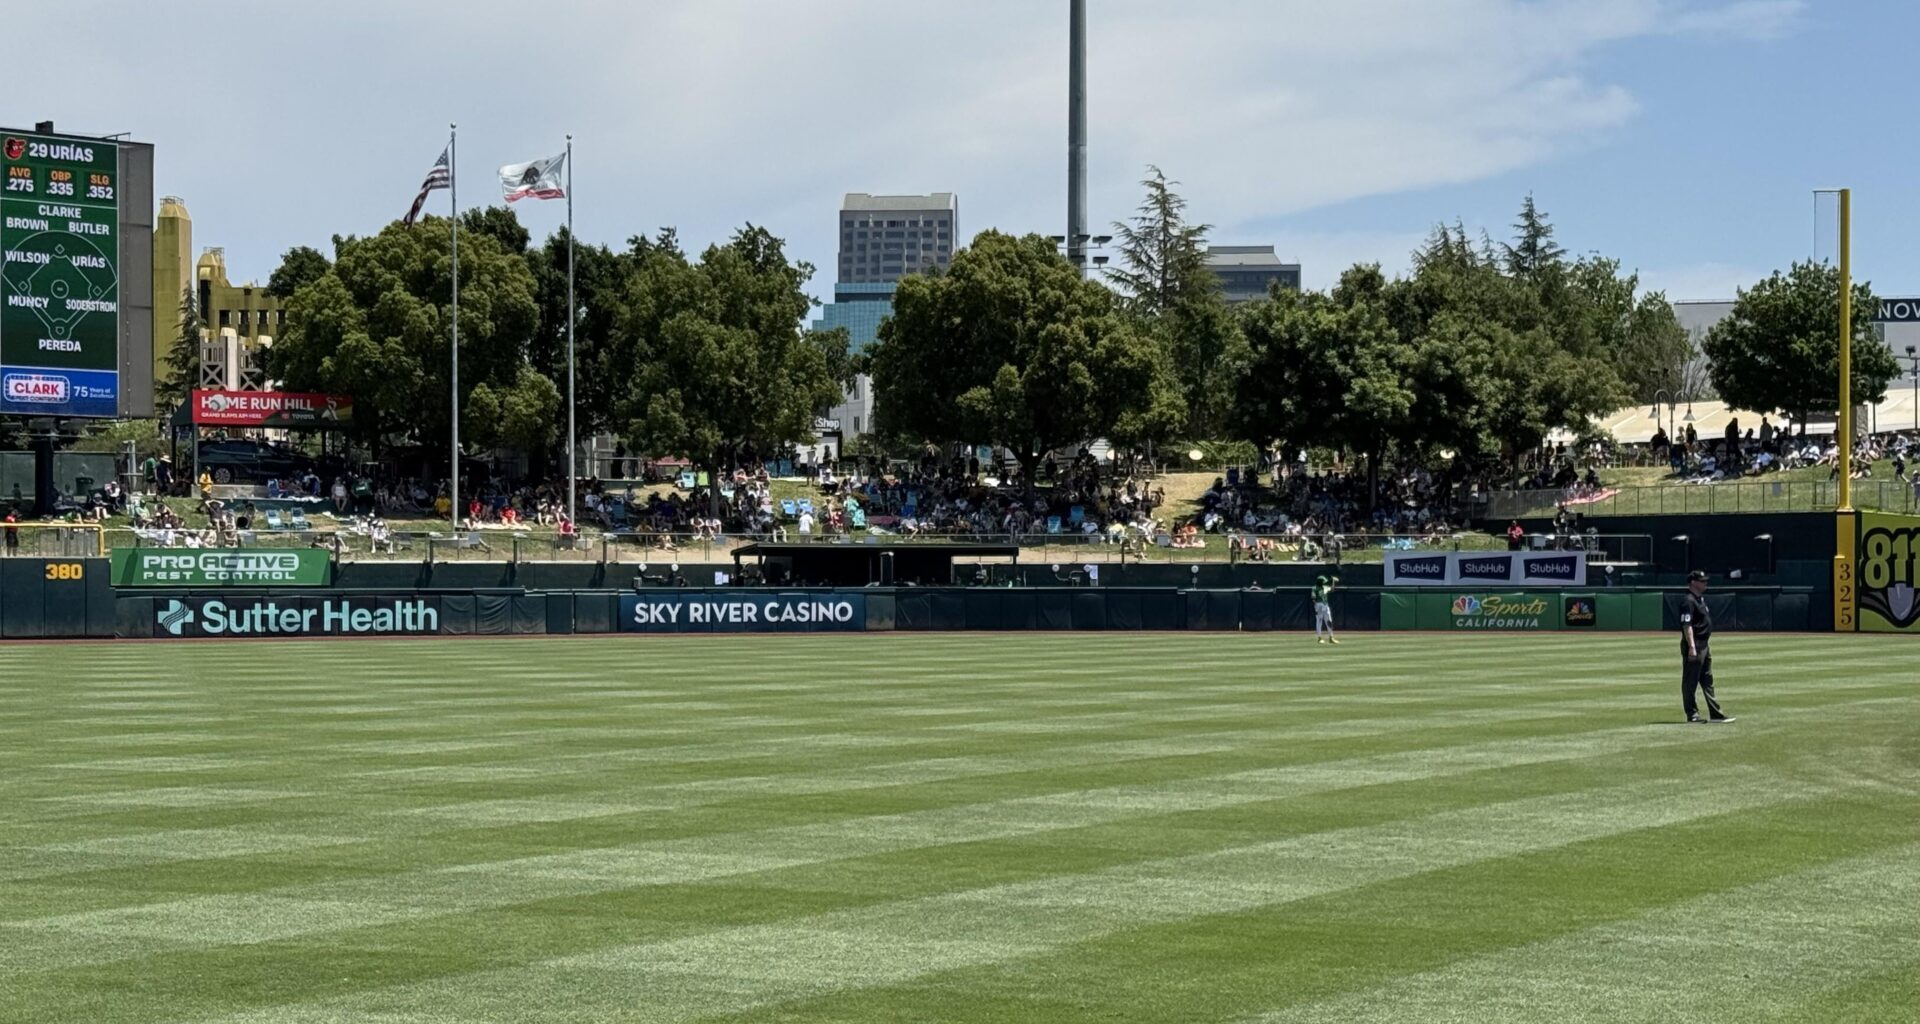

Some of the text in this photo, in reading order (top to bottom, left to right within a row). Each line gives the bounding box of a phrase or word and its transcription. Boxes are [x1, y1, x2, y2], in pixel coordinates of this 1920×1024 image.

[29, 143, 94, 162] 29 URÍAS
[9, 167, 31, 178] AVG
[51, 170, 72, 181] OBP
[6, 178, 34, 192] .275
[90, 174, 110, 185] SLG
[46, 182, 74, 196] .335
[86, 186, 114, 199] .352
[38, 205, 82, 219] CLARKE
[6, 217, 49, 231] BROWN
[68, 221, 110, 235] BUTLER
[5, 250, 50, 264] WILSON
[72, 255, 106, 268] URÍAS
[8, 295, 49, 308] MUNCY
[66, 299, 117, 312] SODERSTROM
[38, 339, 82, 352] PEREDA
[14, 382, 60, 395] CLARK
[73, 386, 88, 398] 75
[251, 397, 281, 410] RUN
[285, 398, 314, 411] HILL
[143, 555, 296, 569] PRO ACTIVE
[1400, 563, 1440, 573] StubHub
[1465, 563, 1505, 573] StubHub
[1530, 563, 1570, 573] StubHub
[45, 563, 83, 580] 380
[143, 571, 296, 580] PEST CONTROL
[634, 601, 853, 623] SKY RIVER CASINO
[1481, 596, 1548, 616] Sports
[202, 600, 438, 633] Sutter Health
[1456, 618, 1539, 628] CALIFORNIA
